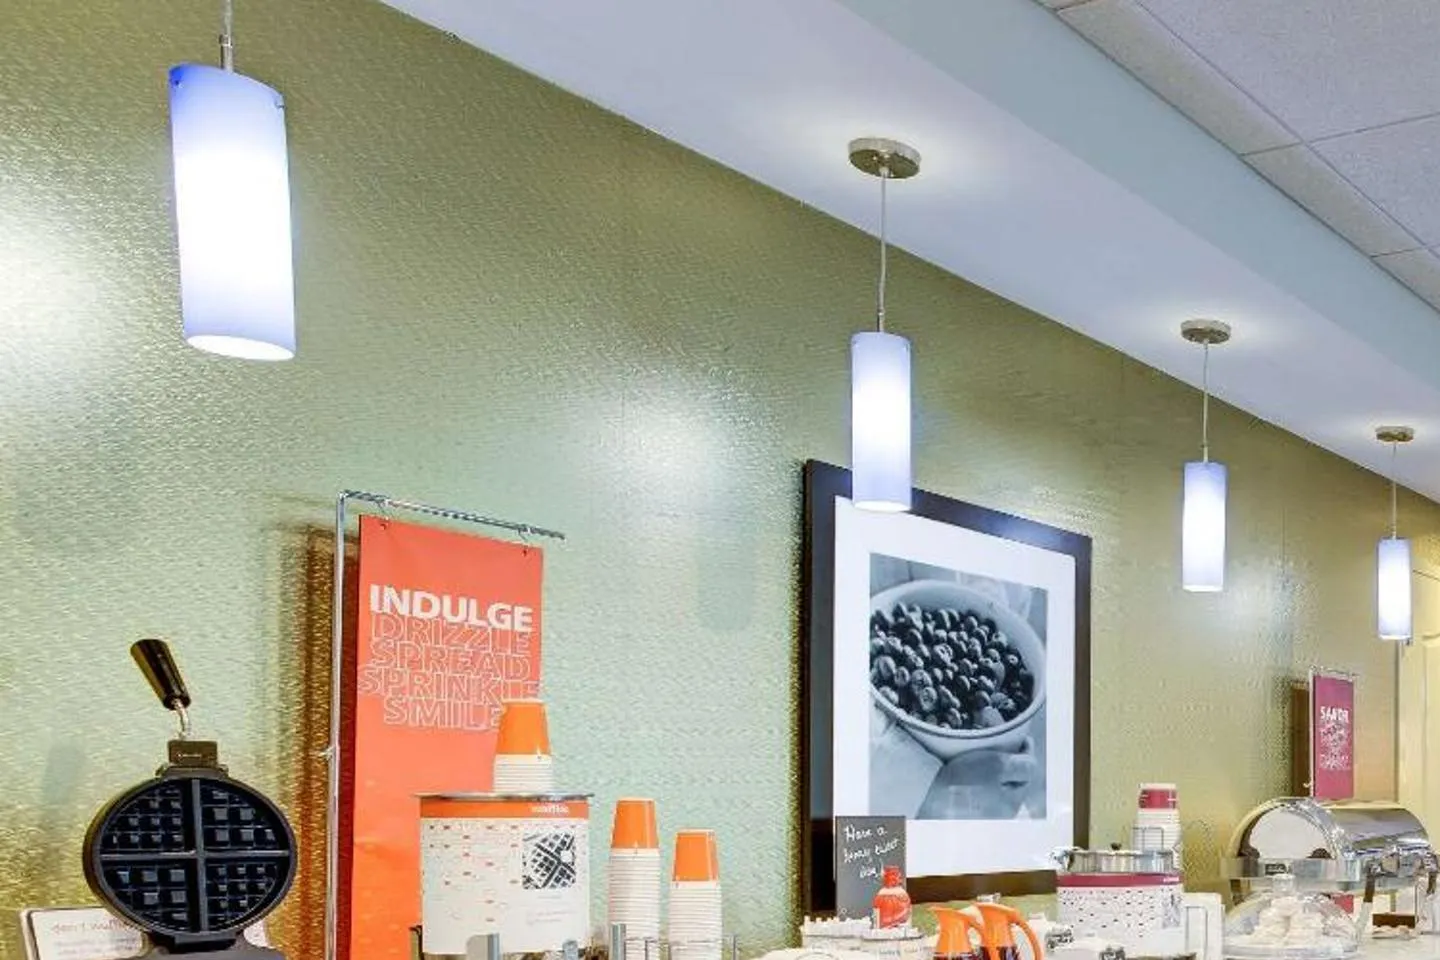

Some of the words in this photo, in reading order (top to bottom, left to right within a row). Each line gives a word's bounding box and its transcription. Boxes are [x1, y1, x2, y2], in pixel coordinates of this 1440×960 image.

[369, 583, 533, 632] INDULGE
[371, 614, 533, 657] DRIZZLE
[369, 637, 532, 682] SPREAD
